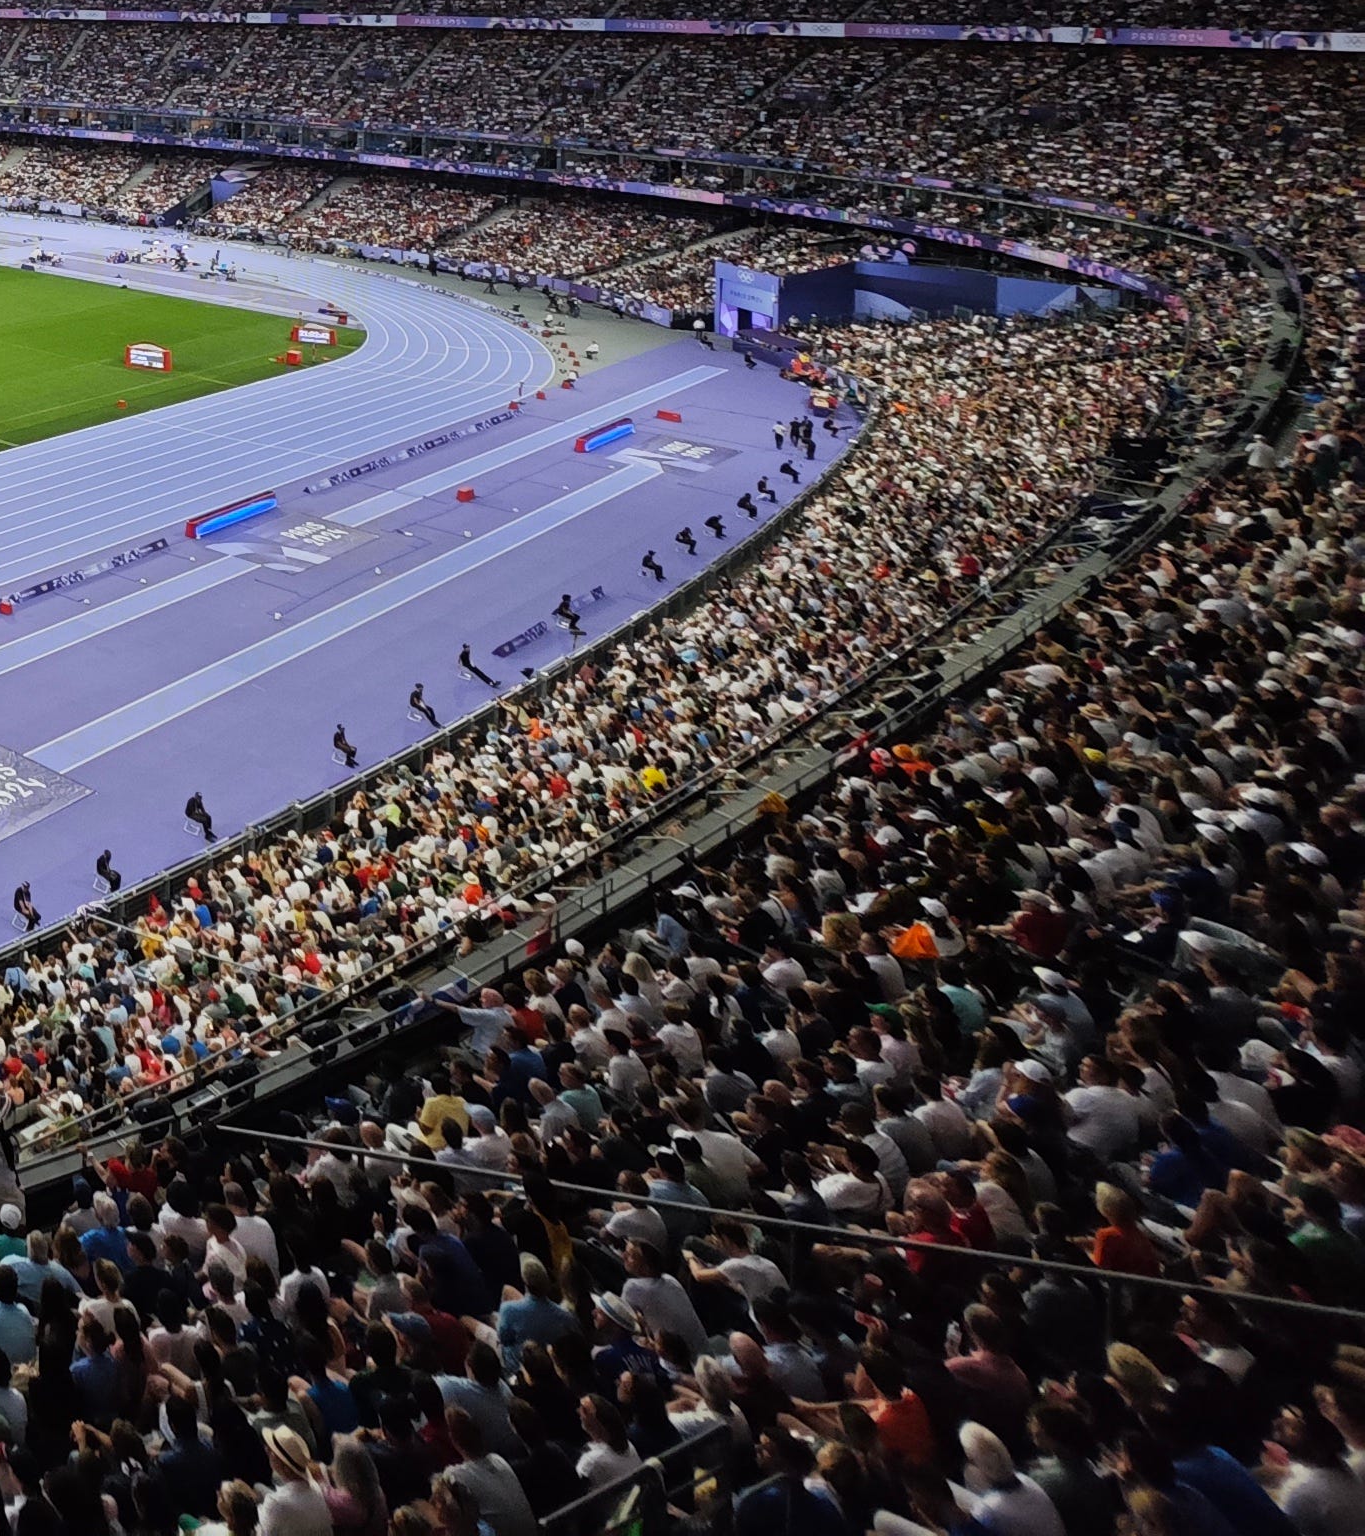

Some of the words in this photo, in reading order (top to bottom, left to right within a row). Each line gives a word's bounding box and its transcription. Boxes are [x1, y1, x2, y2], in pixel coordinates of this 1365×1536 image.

[414, 16, 440, 26] PARIS
[442, 17, 468, 27] 2024
[626, 21, 657, 30] PARIS
[659, 22, 687, 31] 2024
[868, 26, 900, 36] PARIS
[903, 27, 935, 37] 2024
[1131, 31, 1167, 42] PARIS
[1170, 33, 1204, 43] 2024
[280, 521, 326, 539] PARIS
[303, 528, 349, 547] 2024
